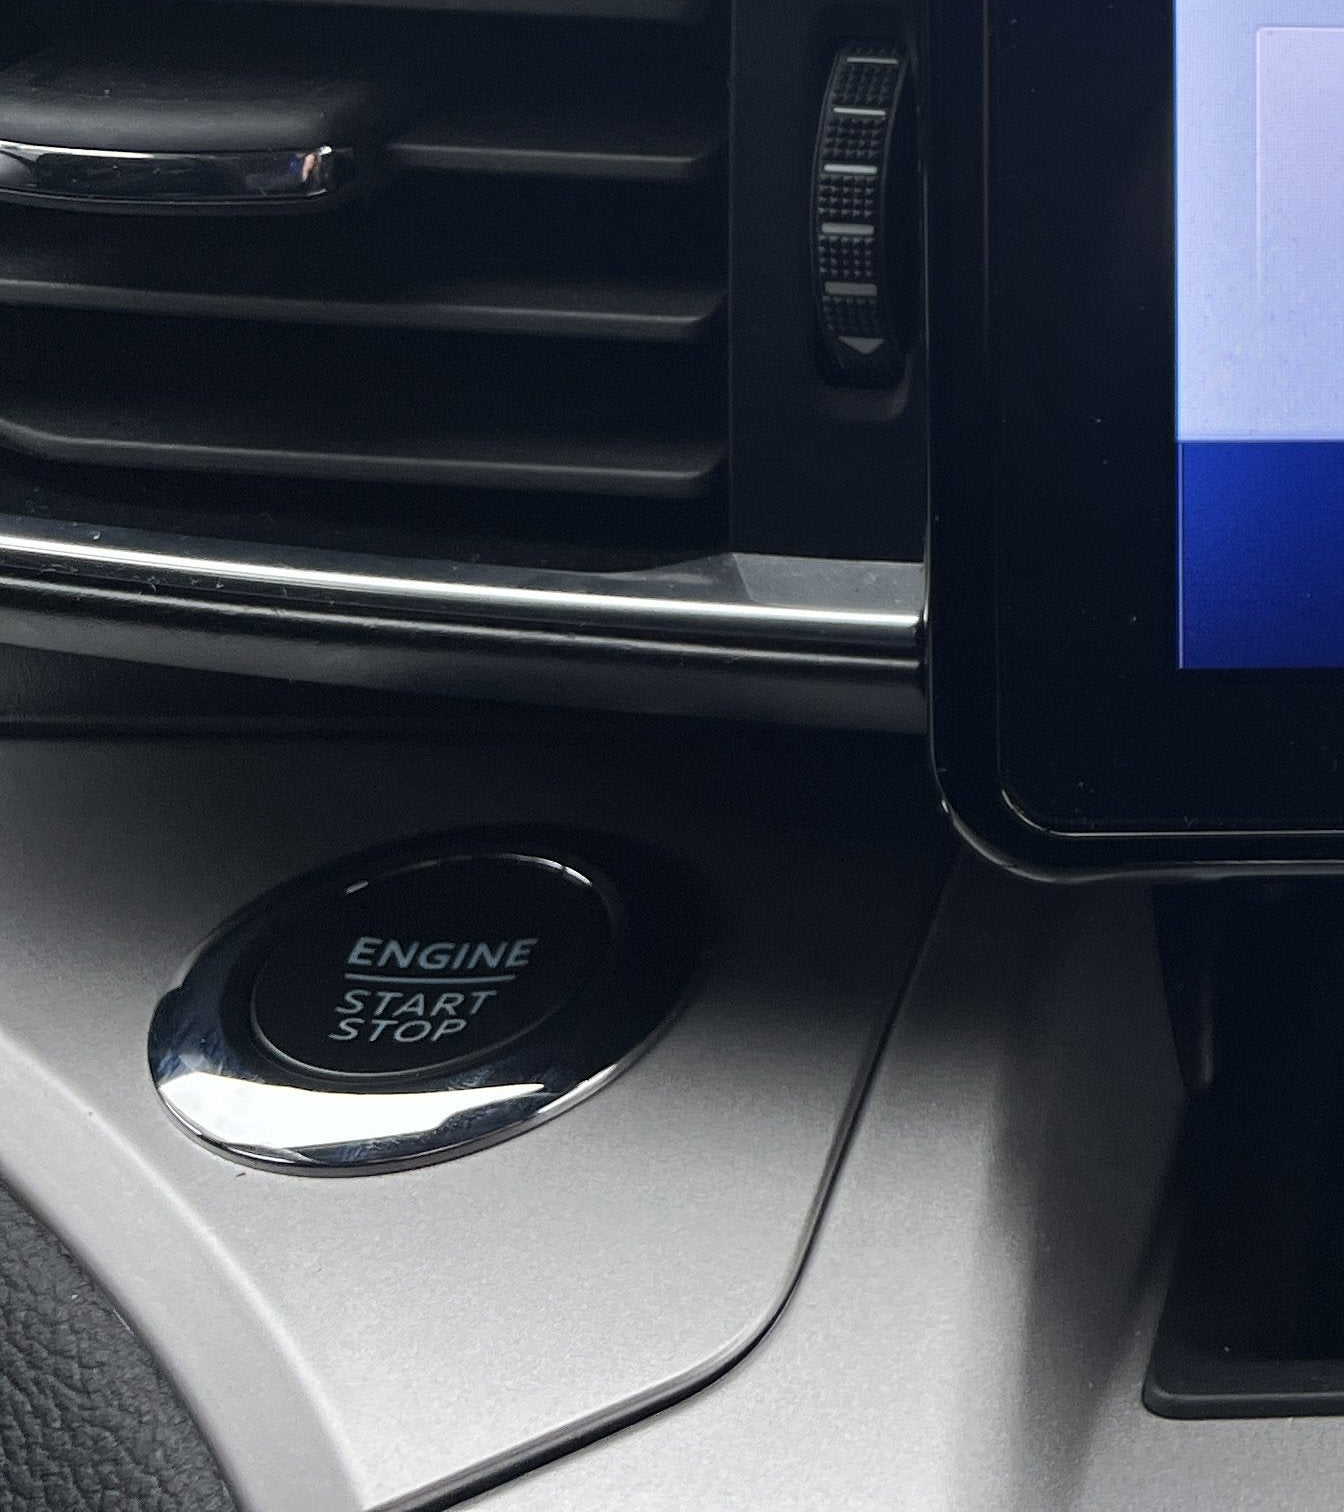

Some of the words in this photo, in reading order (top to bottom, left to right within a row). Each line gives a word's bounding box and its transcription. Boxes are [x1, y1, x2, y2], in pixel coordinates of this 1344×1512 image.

[345, 936, 539, 970] ENGINE
[335, 989, 498, 1017] START
[329, 1017, 468, 1043] STOP
